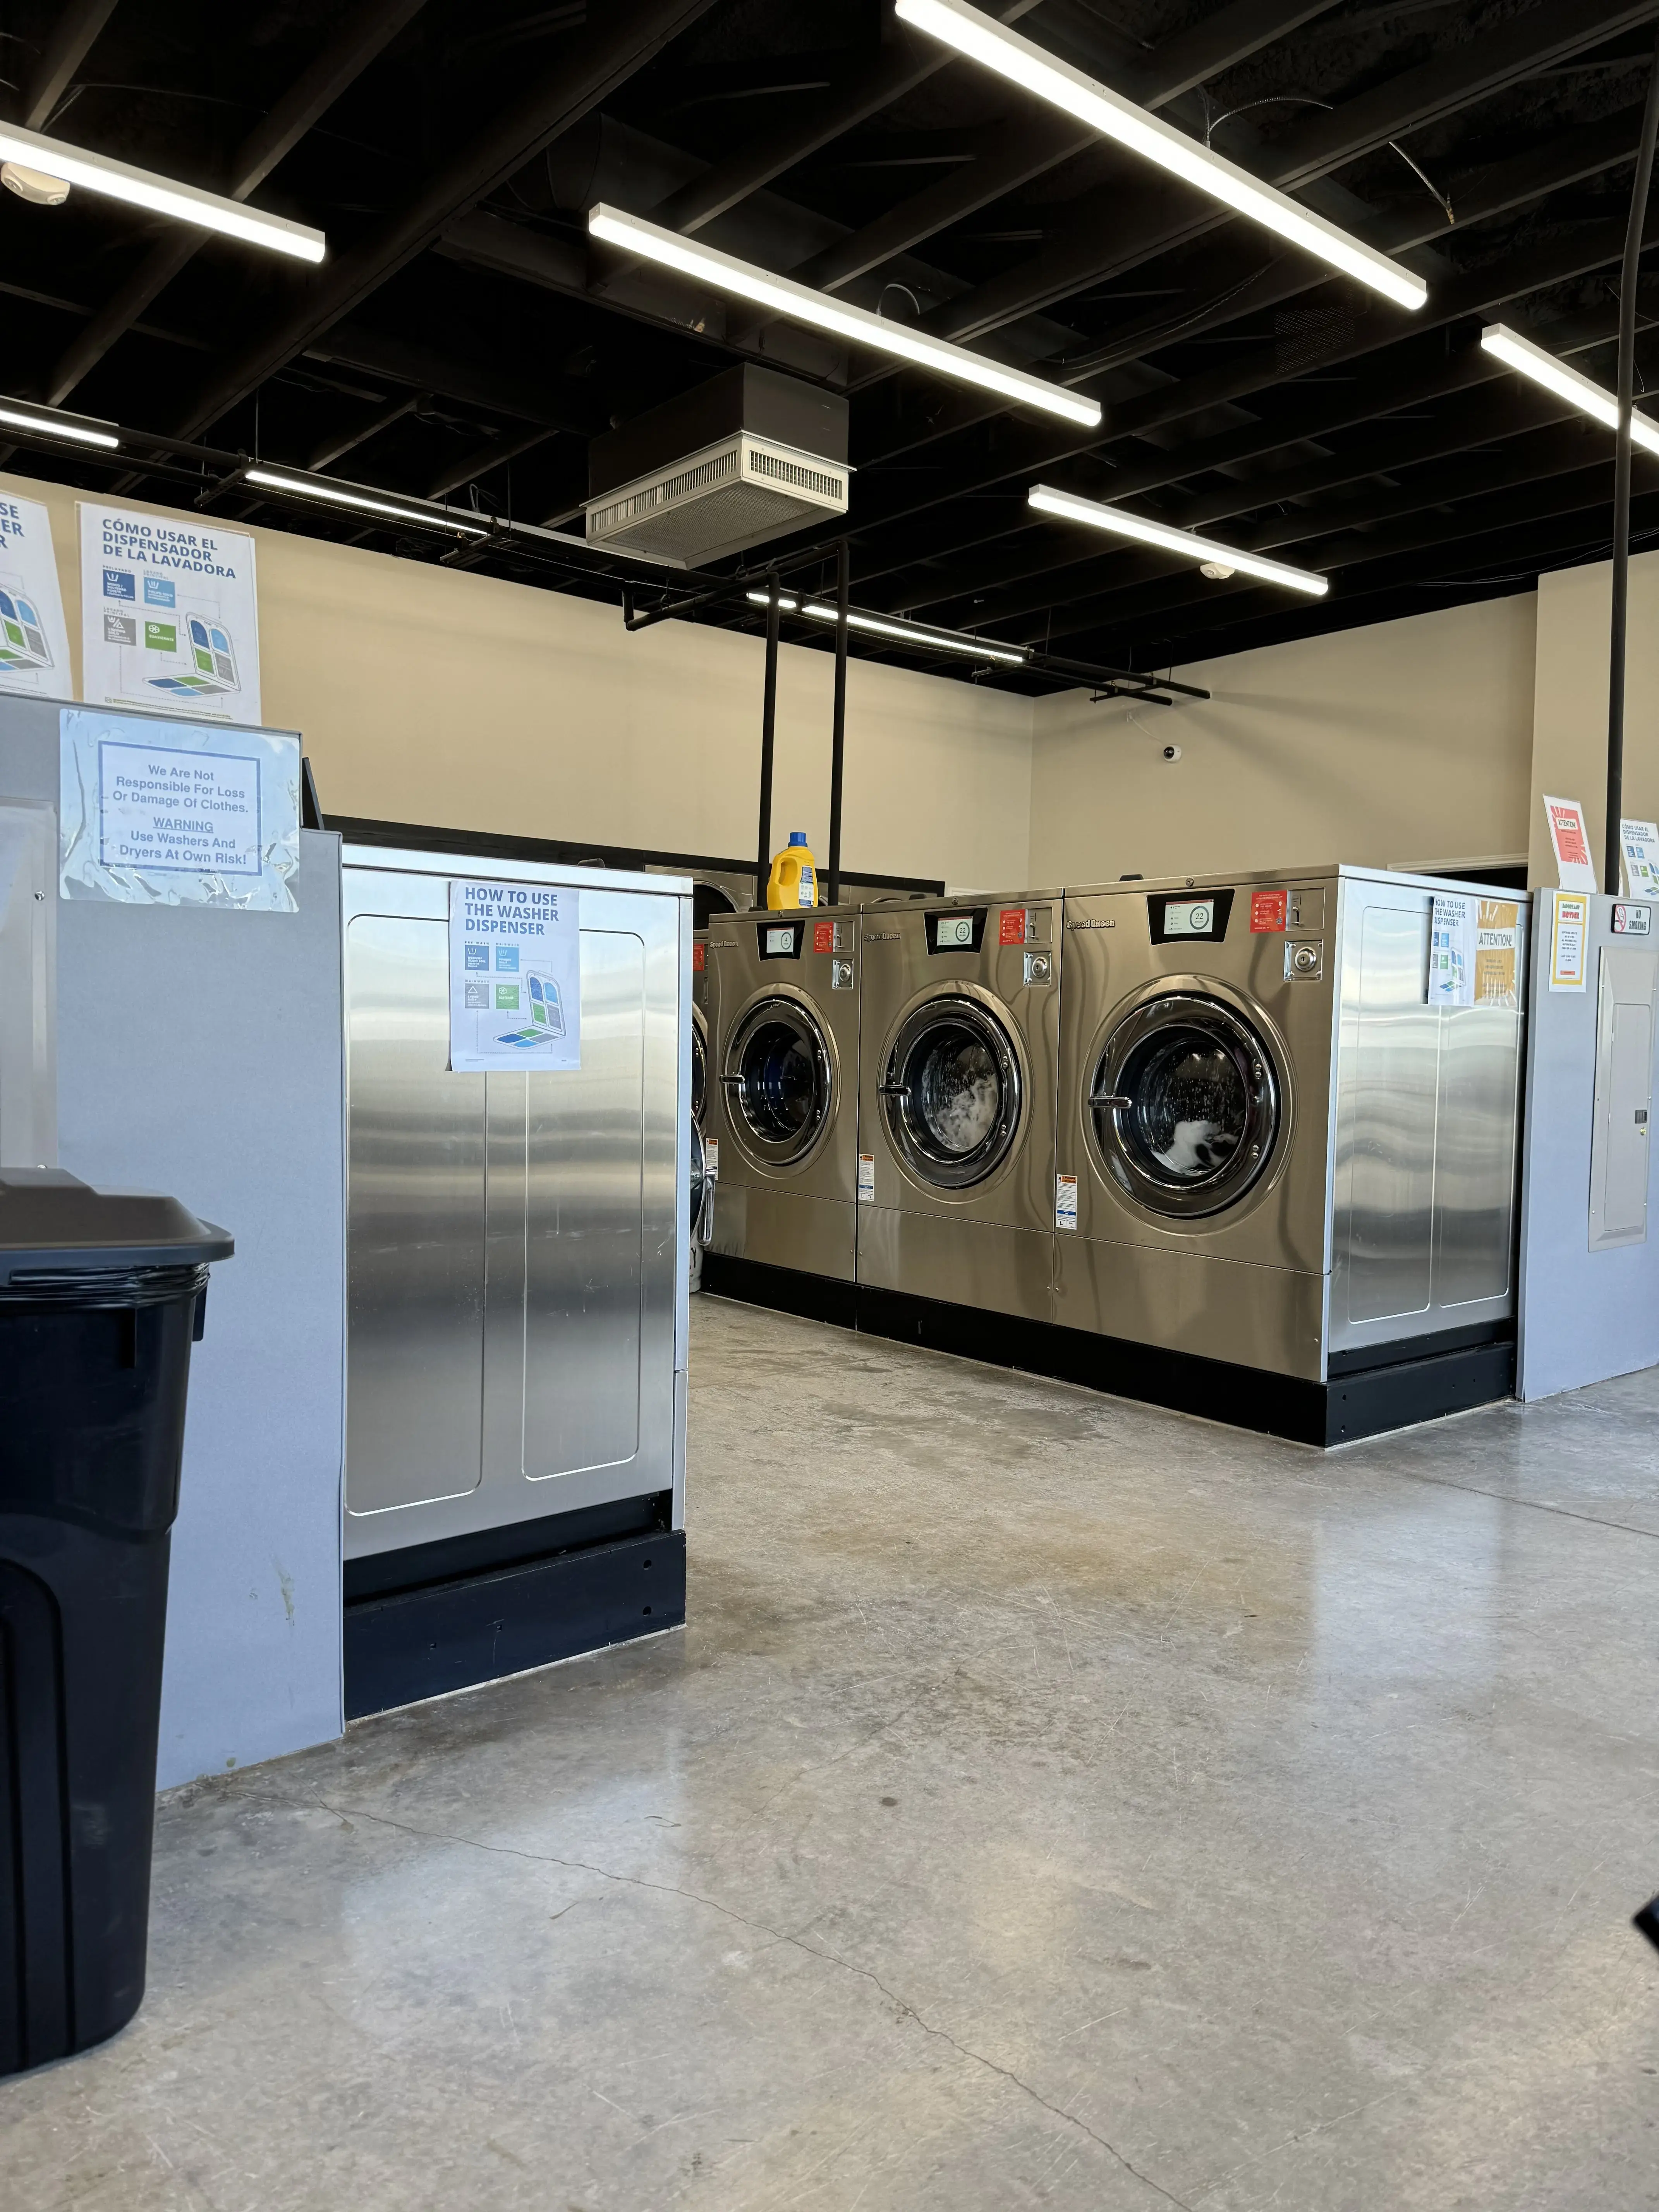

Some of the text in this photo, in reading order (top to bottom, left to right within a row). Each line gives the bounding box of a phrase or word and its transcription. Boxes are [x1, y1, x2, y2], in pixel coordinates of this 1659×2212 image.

[103, 518, 218, 550] CÓMO USAR EL
[103, 531, 212, 562] DISPENSADOR
[103, 544, 236, 579] DE LA LAVADORA
[148, 764, 214, 781] We Are Not
[117, 776, 245, 799] Responsible For Loss
[113, 790, 249, 812] Or Damage Of Clothes.
[153, 817, 213, 832] WARNING
[131, 830, 235, 848] Use Washers And
[120, 845, 246, 864] Dryers At Own Risk!
[465, 887, 557, 906] HOW TO USE
[465, 903, 559, 921] THE WASHER
[1443, 909, 1465, 918] WASHER
[1636, 910, 1641, 919] NO
[465, 919, 545, 935] DISPENSER
[1066, 919, 1115, 931] Speed Queen
[1629, 921, 1646, 930] SMOKING
[1479, 933, 1512, 946] ATTENTION!
